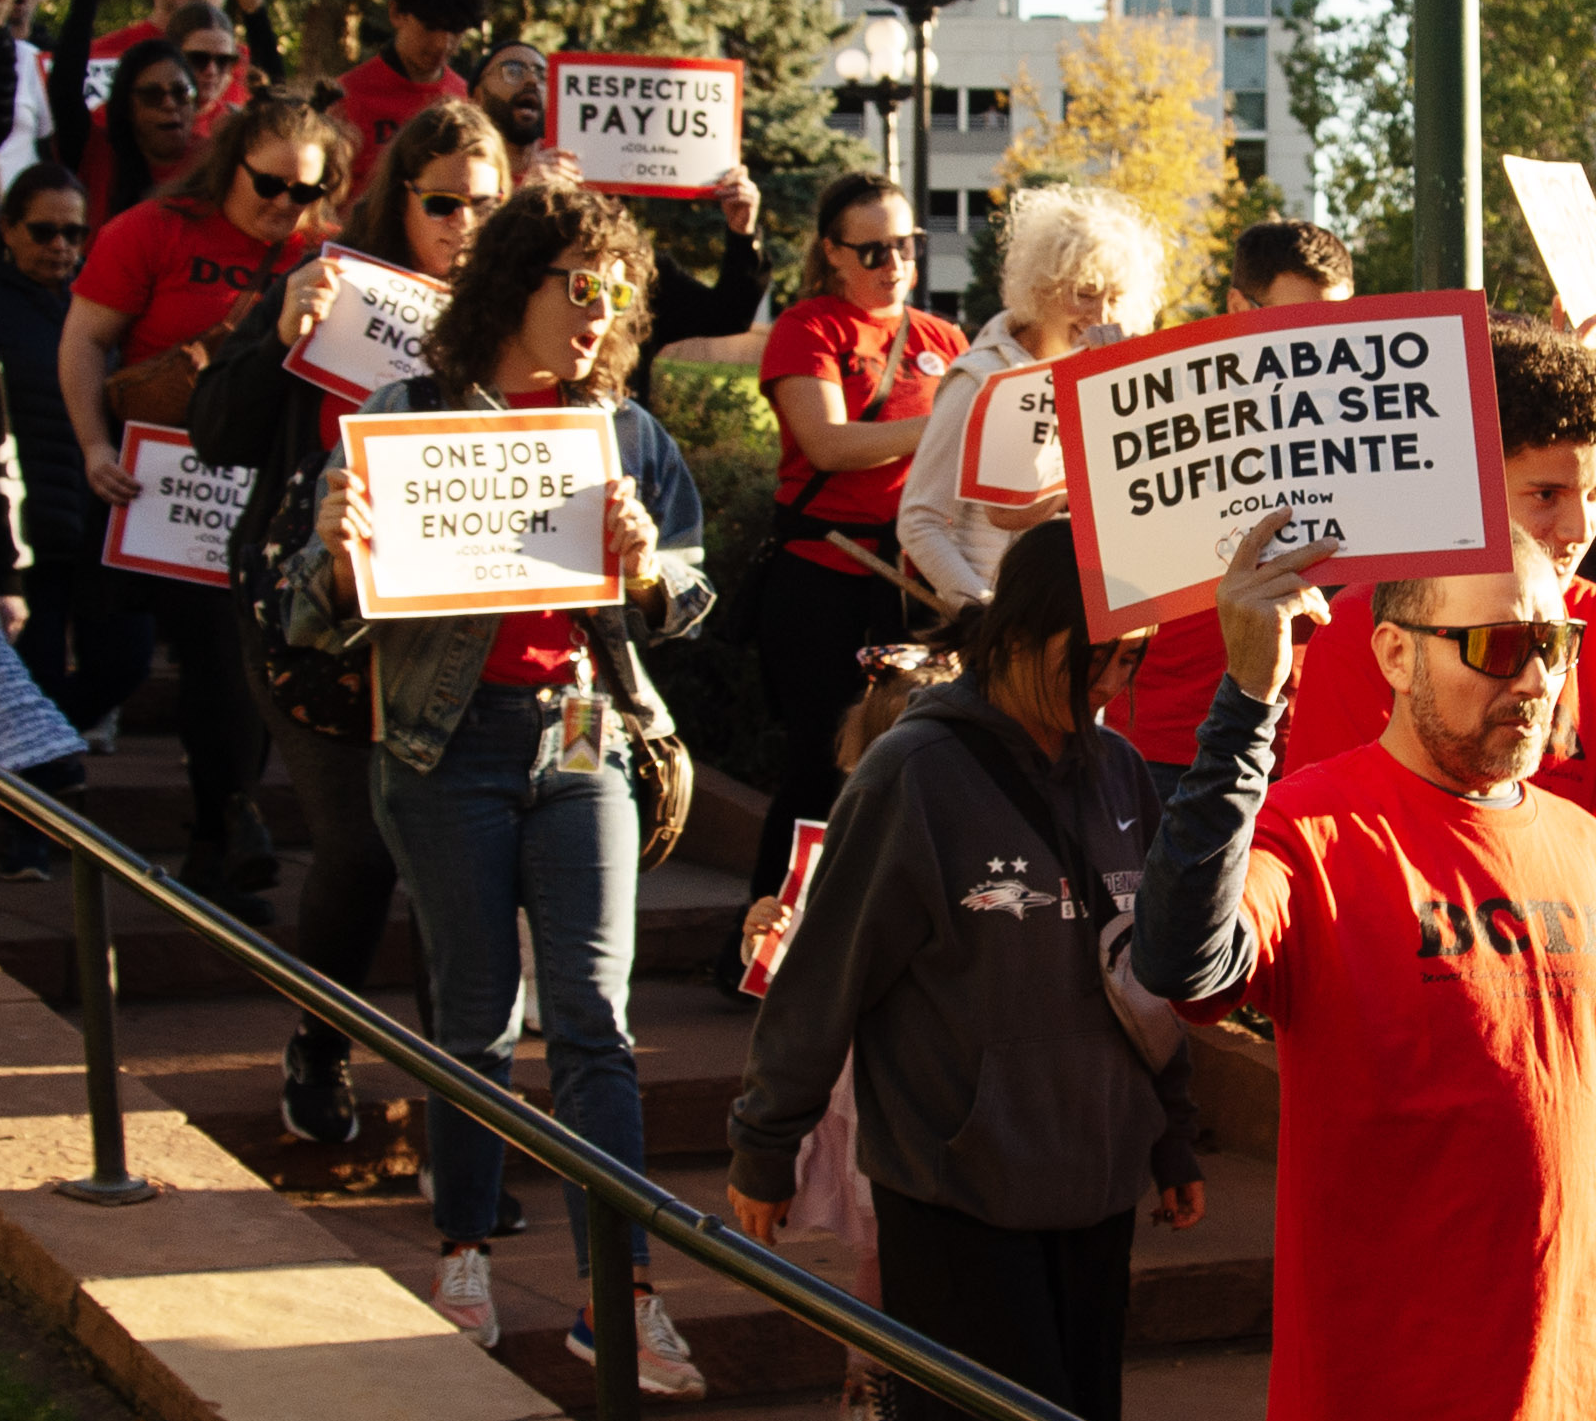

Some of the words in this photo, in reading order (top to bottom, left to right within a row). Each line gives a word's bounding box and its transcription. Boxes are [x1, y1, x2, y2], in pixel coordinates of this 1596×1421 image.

[565, 74, 687, 100] RESPECT
[578, 102, 654, 135] PAY
[667, 107, 717, 139] US.
[636, 163, 677, 177] DCTA
[1109, 366, 1175, 418] UN
[1186, 331, 1431, 397] TRABAJO
[1112, 381, 1326, 472] DEBERÍA
[1338, 380, 1441, 423] SER
[422, 443, 487, 468] ONE
[495, 441, 552, 472] JOB
[404, 476, 529, 505] SHOULD
[539, 474, 575, 499] BE
[1127, 432, 1436, 518] SUFICIENTE.
[160, 477, 246, 509] SHOUL
[421, 509, 557, 539] ENOUGH.
[1250, 517, 1347, 545] CTA
[475, 563, 529, 581] DCTA
